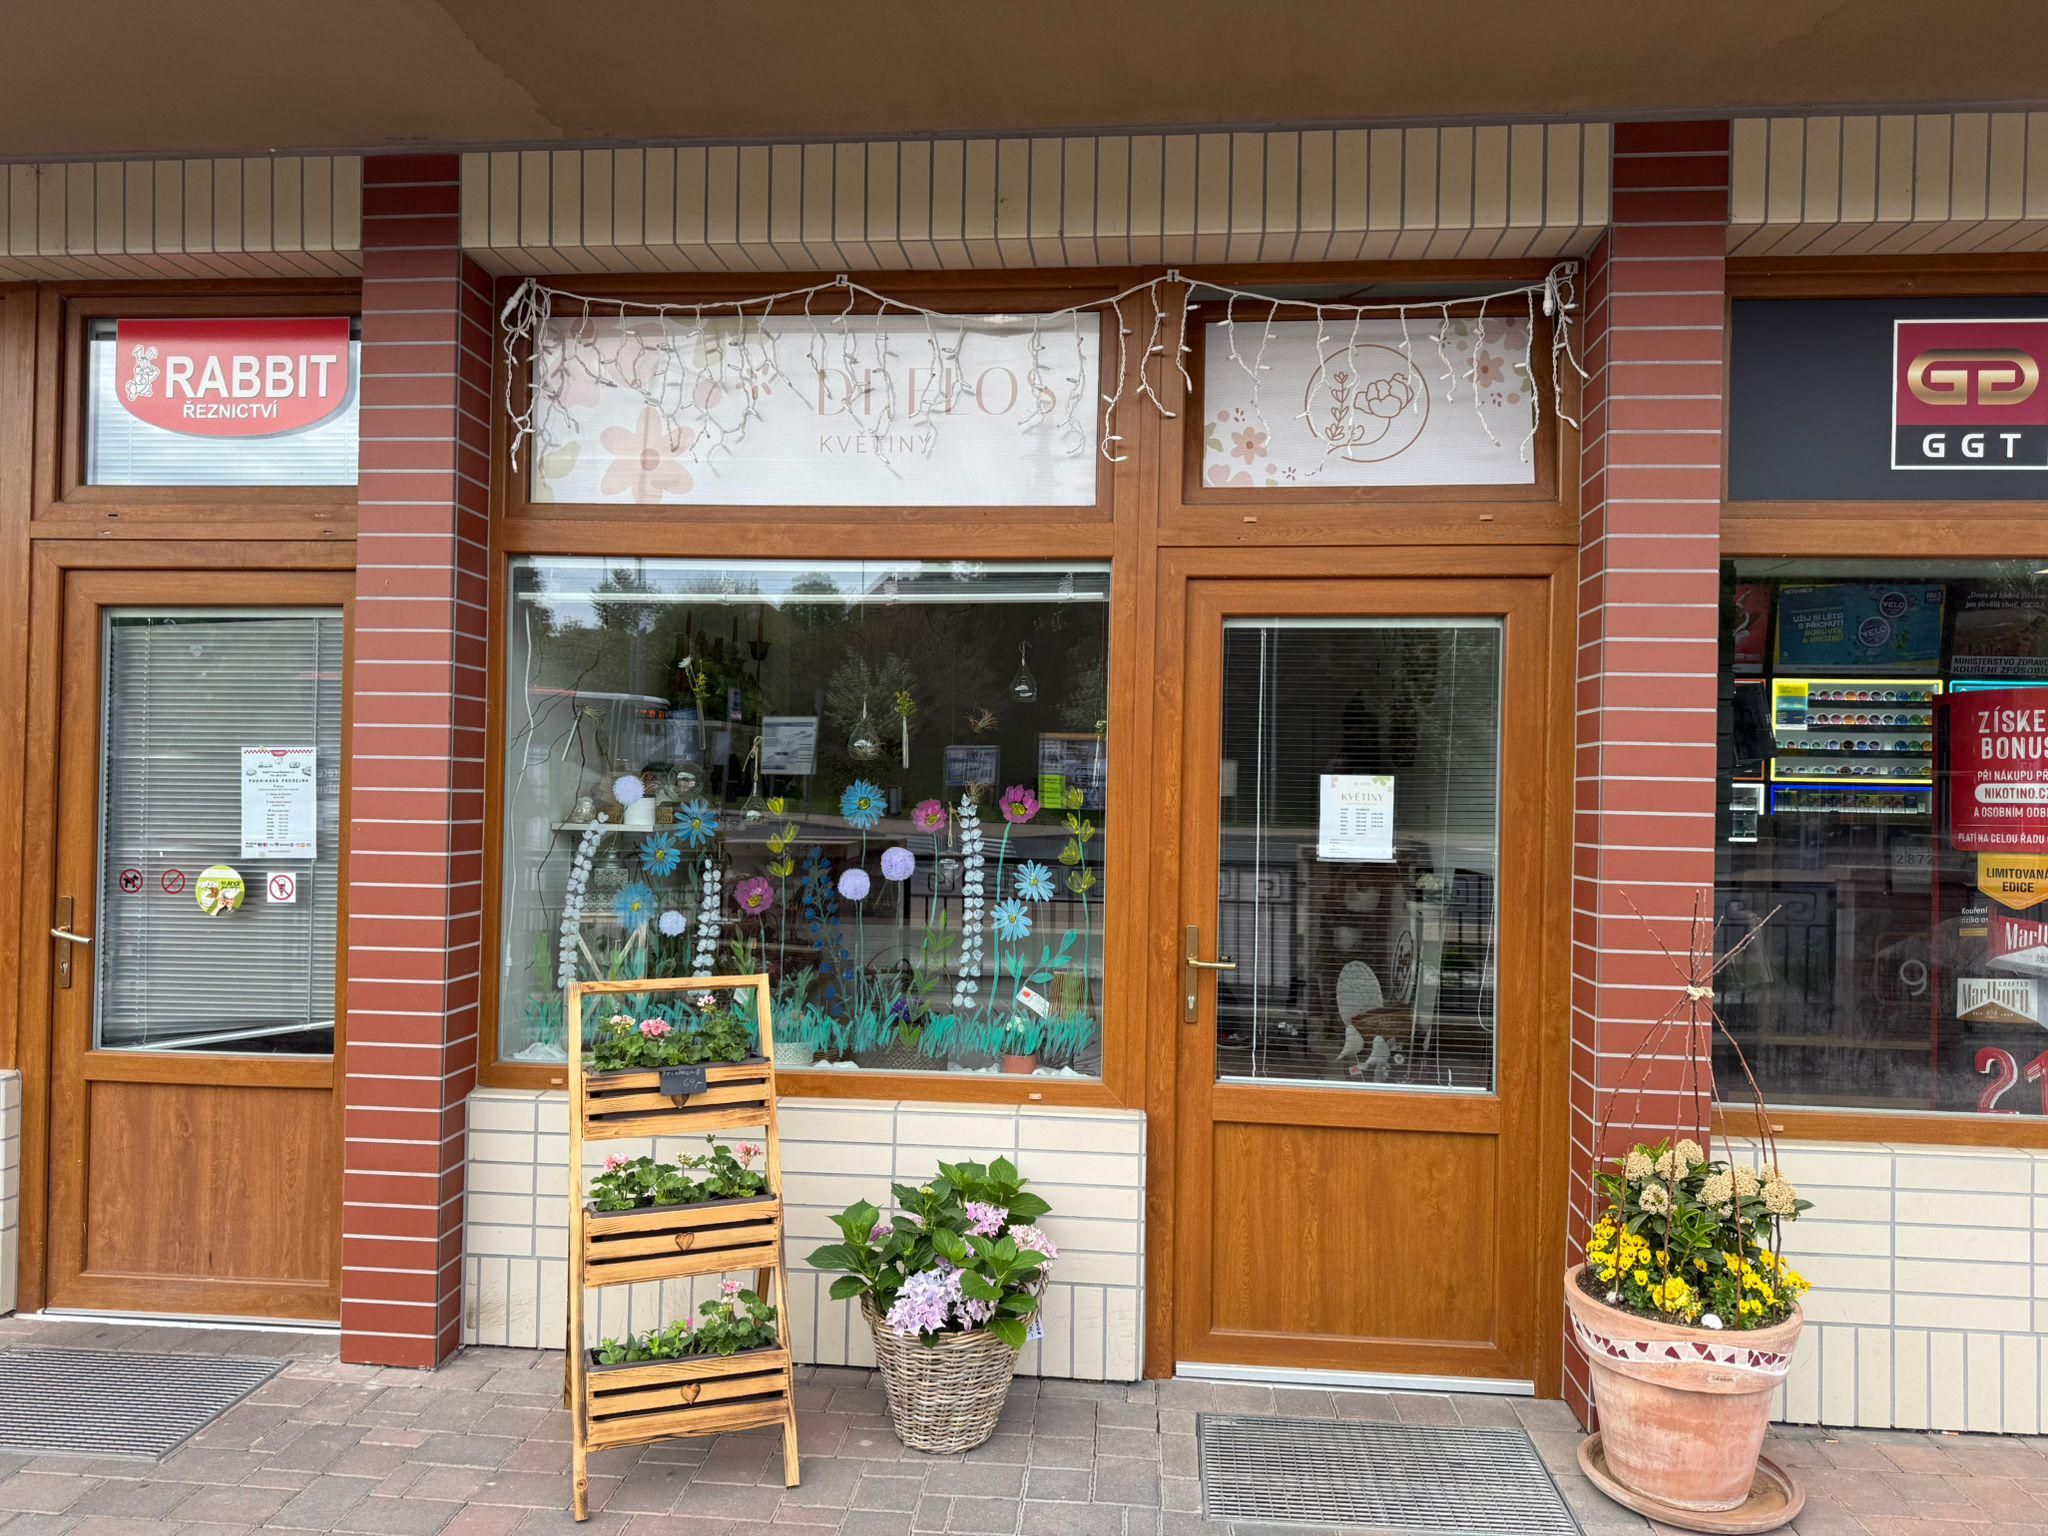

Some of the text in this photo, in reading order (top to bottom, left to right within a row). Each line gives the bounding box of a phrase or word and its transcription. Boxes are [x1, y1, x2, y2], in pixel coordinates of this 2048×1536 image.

[165, 354, 337, 399] RABBIT
[183, 400, 278, 419] ŘEZNICTVÍ
[819, 430, 933, 454] KVĚTINY
[1922, 433, 2022, 458] GGT
[1882, 601, 1905, 609] VELO
[1861, 625, 1888, 638] VELO
[1954, 657, 2015, 666] MINISTERSTVO
[1978, 705, 2046, 734] ZÍSKE
[1977, 768, 1992, 781] PŘI
[1994, 768, 2033, 781] NÁKUPU
[1973, 807, 1980, 817] A
[1981, 804, 2024, 818] OSOBNÍM
[1958, 831, 2045, 844] PLATÍ NA CELOU ŘADU
[2002, 882, 2035, 893] EDICE
[1961, 981, 2029, 1013] Marlboro
